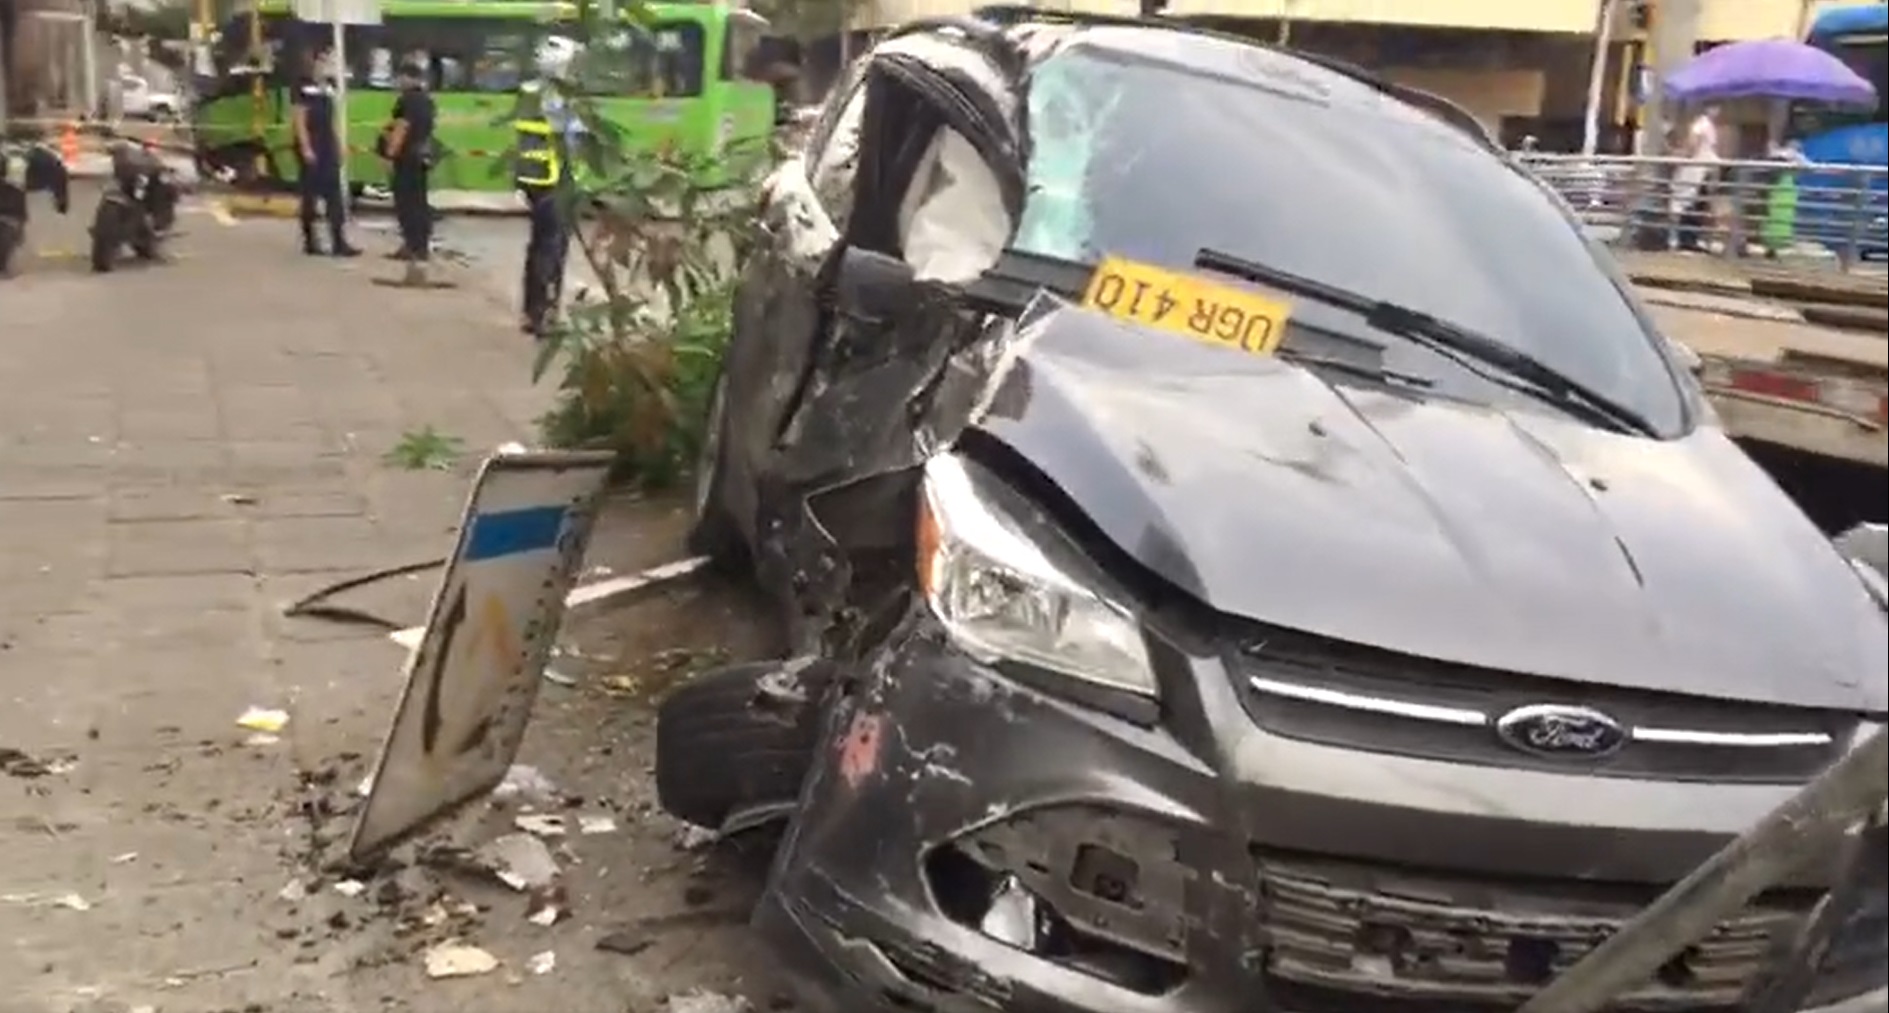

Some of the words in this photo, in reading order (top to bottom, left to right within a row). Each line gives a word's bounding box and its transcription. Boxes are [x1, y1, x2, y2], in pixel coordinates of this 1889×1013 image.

[1094, 273, 1177, 322] 410
[1187, 298, 1272, 351] UGR
[1529, 713, 1604, 749] Ford
